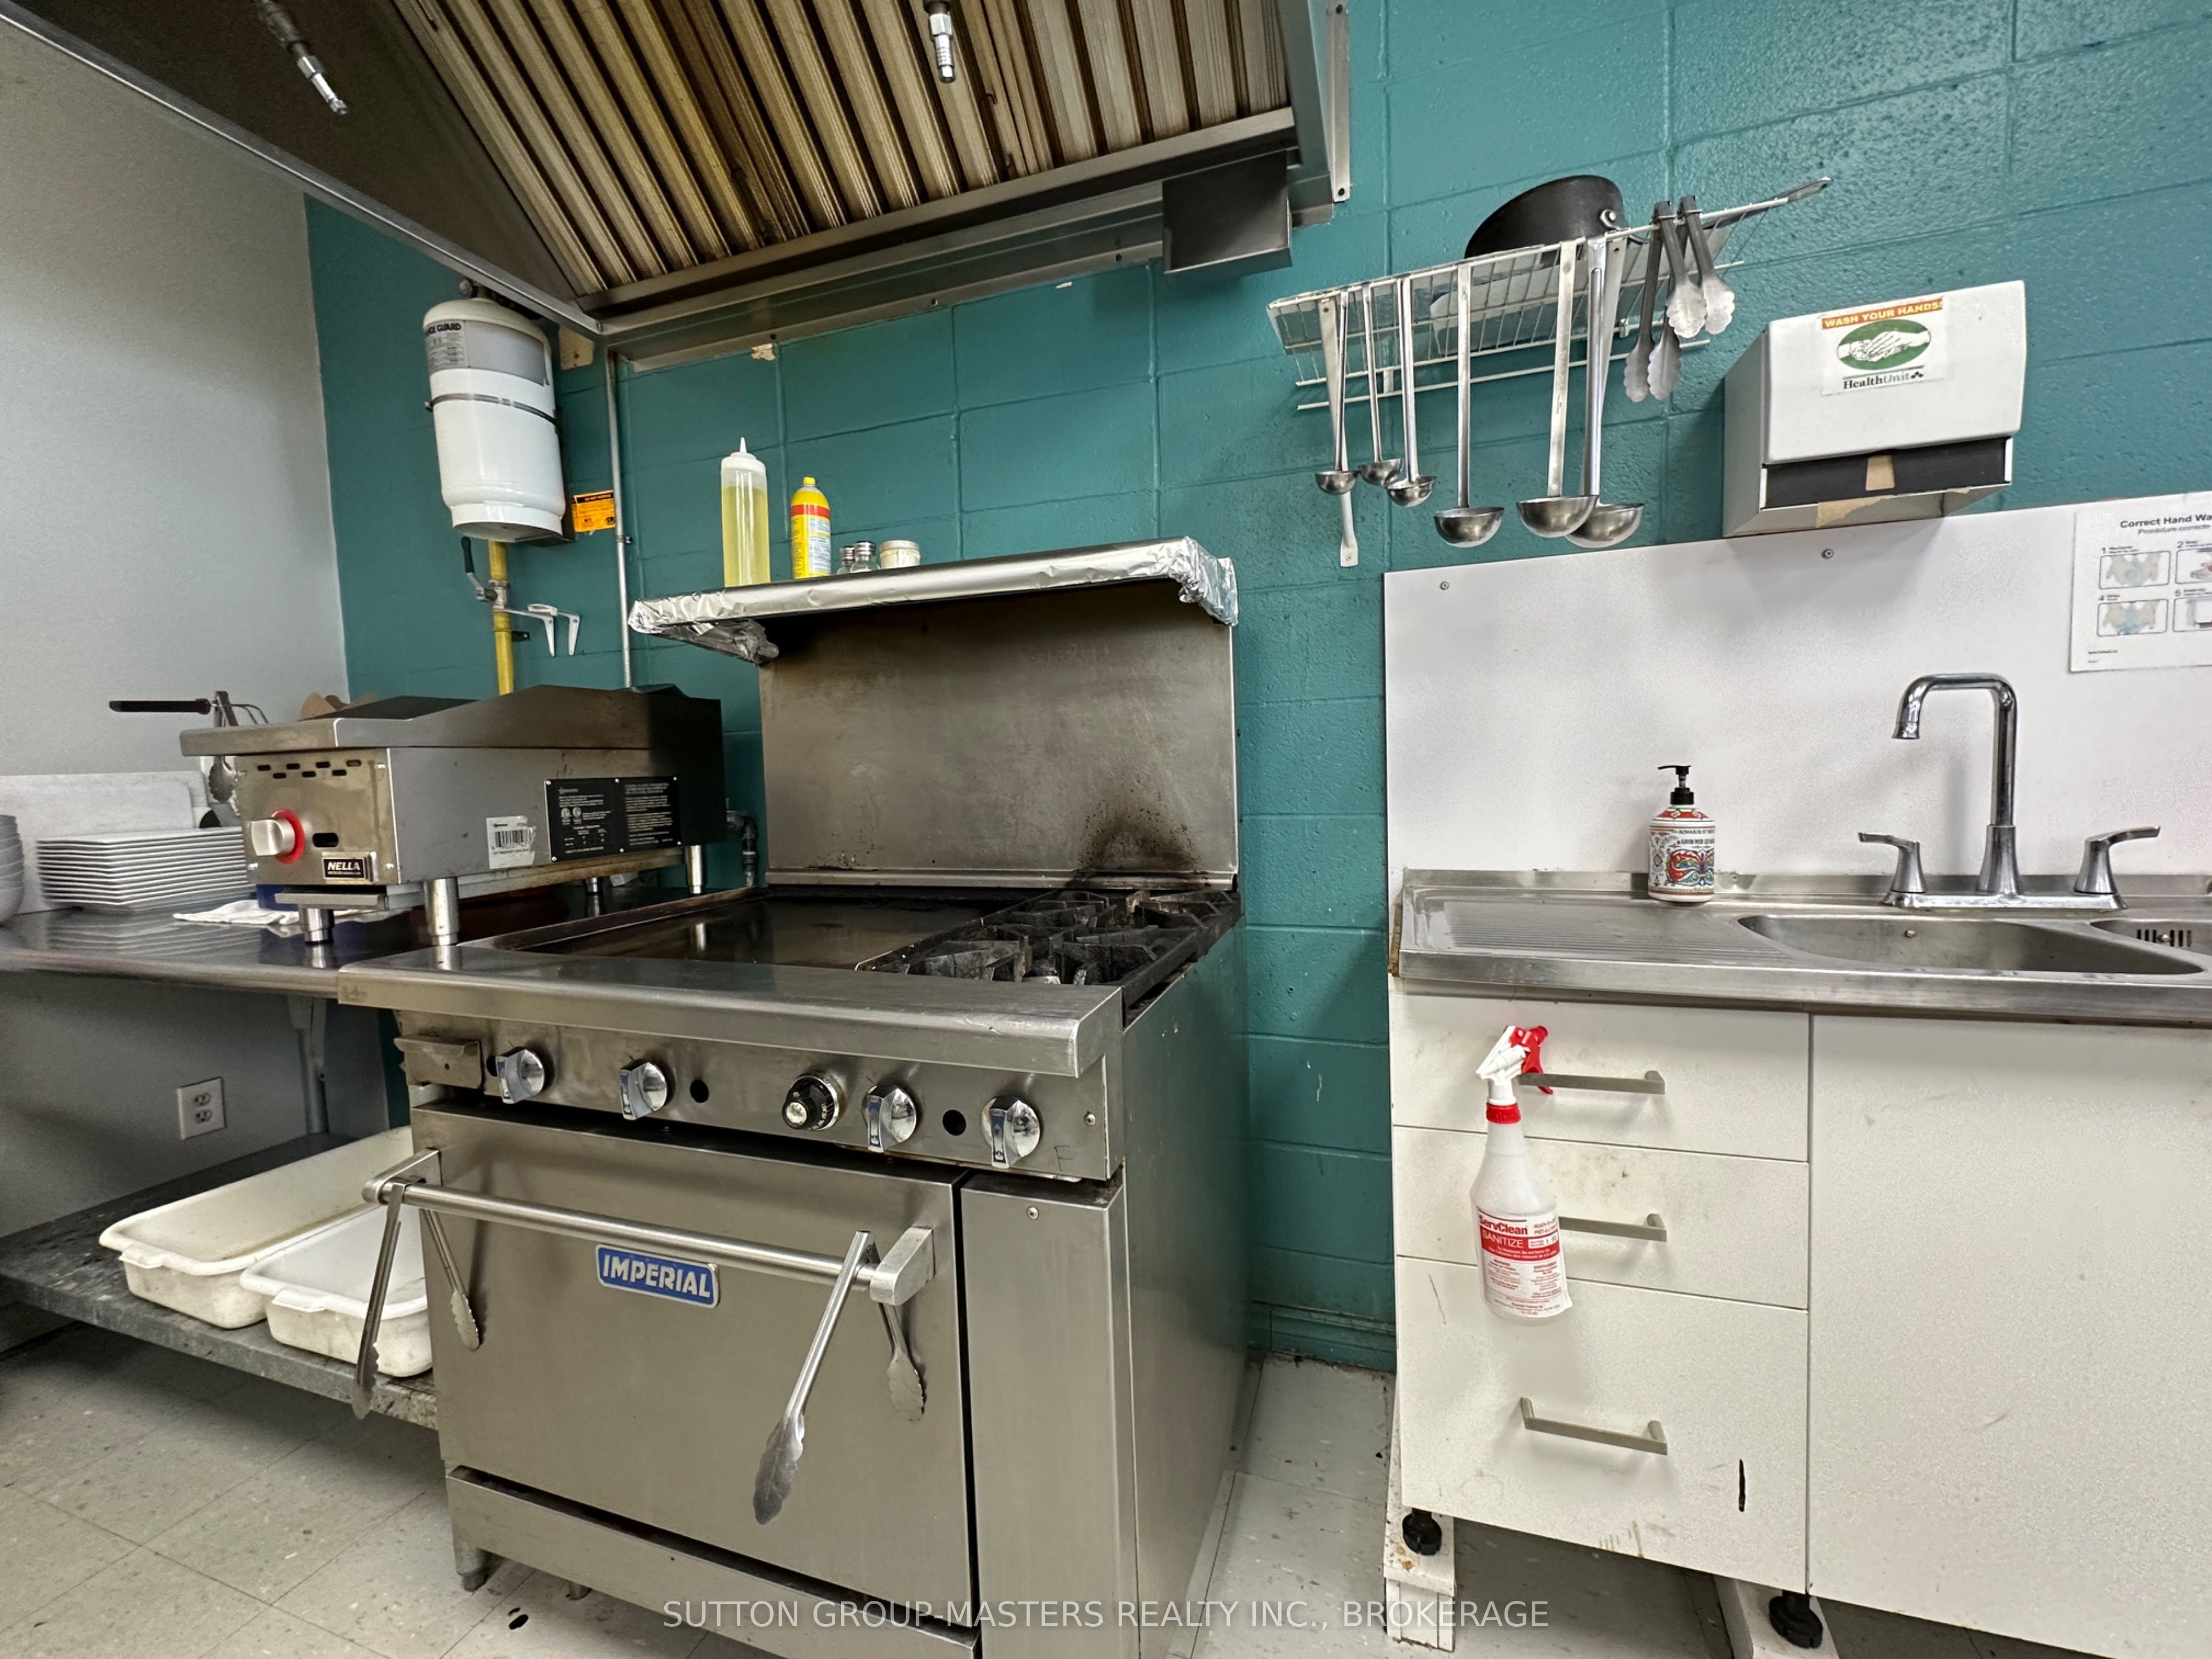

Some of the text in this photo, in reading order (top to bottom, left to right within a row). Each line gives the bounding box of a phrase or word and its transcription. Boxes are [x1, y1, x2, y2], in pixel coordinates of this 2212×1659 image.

[1824, 301, 1942, 328] WASH YOUR HANDS!
[2120, 518, 2160, 528] Correct
[2164, 515, 2192, 524] Hand
[328, 862, 361, 870] NELLA
[1479, 1214, 1528, 1234] ServClean
[1482, 1229, 1524, 1248] SANITIZE
[603, 1254, 710, 1298] IMPERIAL
